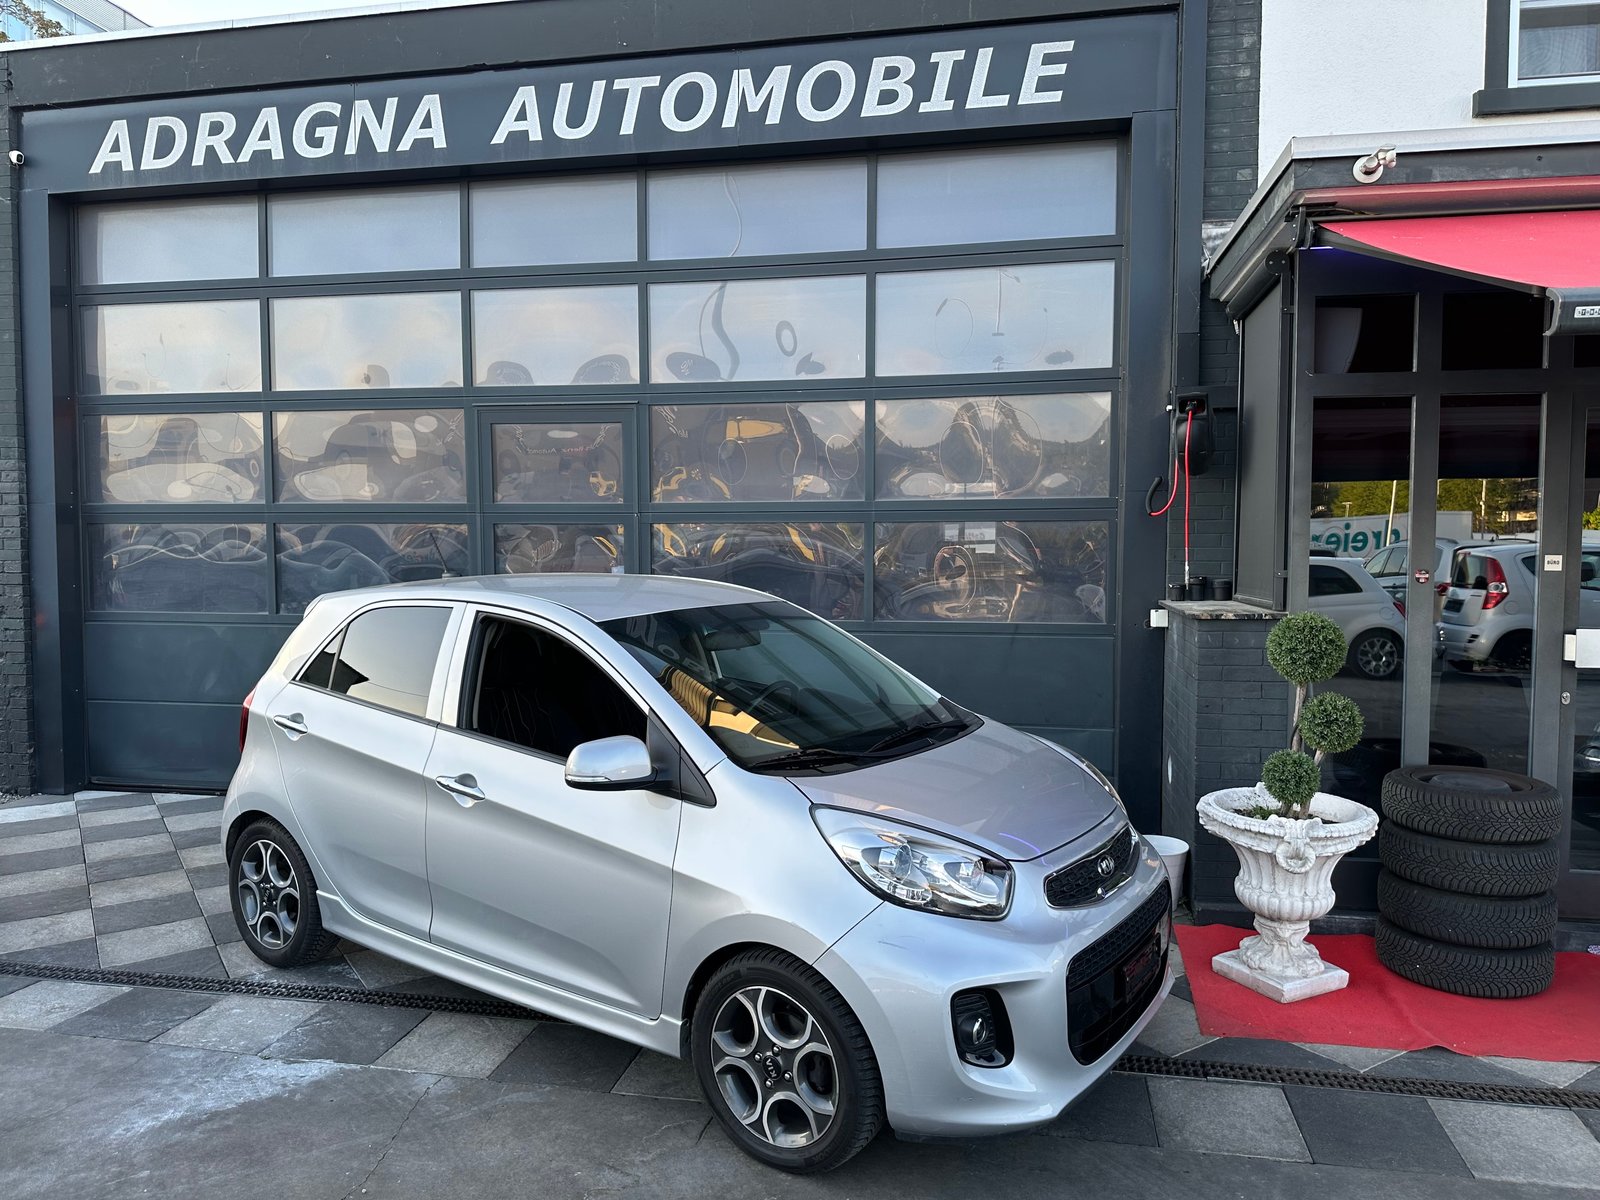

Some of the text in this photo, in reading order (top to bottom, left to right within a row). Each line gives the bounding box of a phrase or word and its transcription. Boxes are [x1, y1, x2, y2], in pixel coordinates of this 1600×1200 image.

[89, 40, 1075, 174] ADRAGNA AUTOMOBILE
[765, 1058, 777, 1078] KIA
